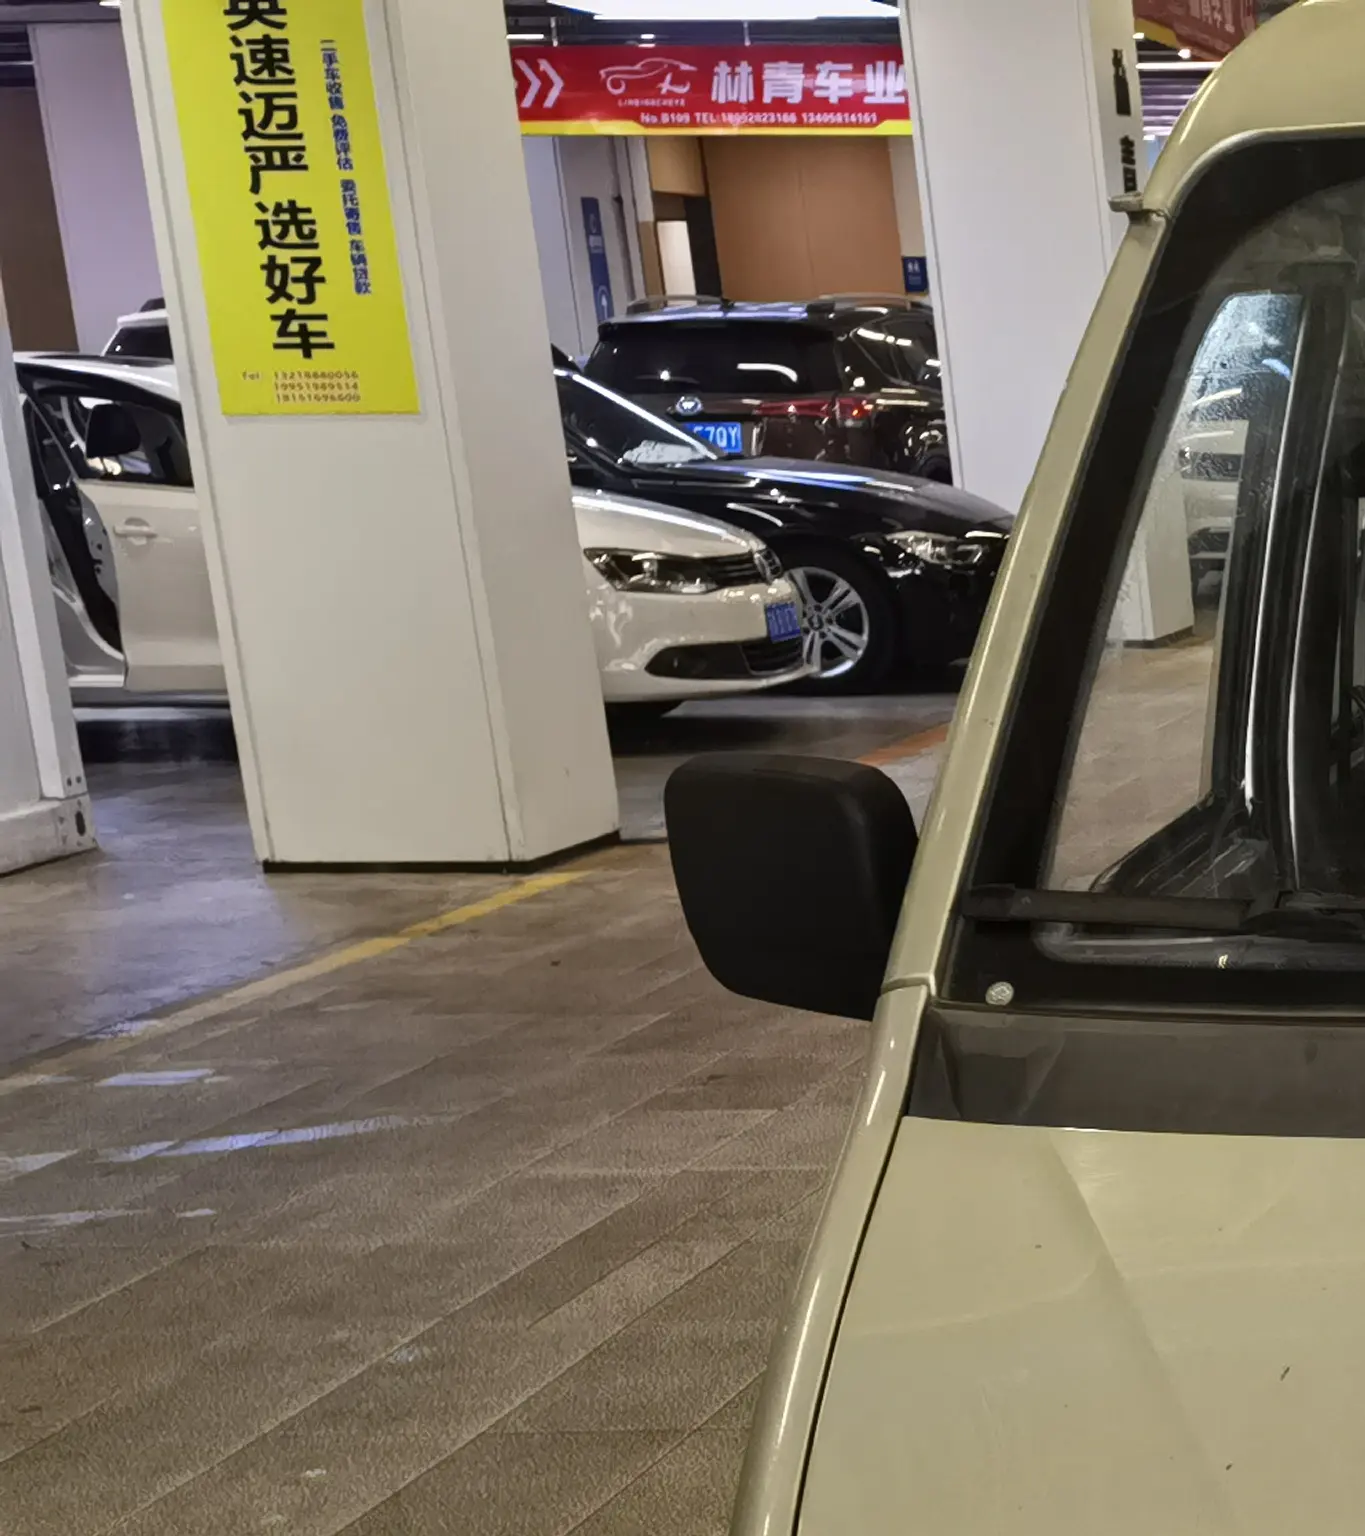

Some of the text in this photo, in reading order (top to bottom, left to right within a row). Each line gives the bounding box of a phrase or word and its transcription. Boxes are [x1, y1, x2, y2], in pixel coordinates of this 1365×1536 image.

[223, 0, 335, 359] 英速迈严选好车
[711, 60, 908, 104] 林青车业
